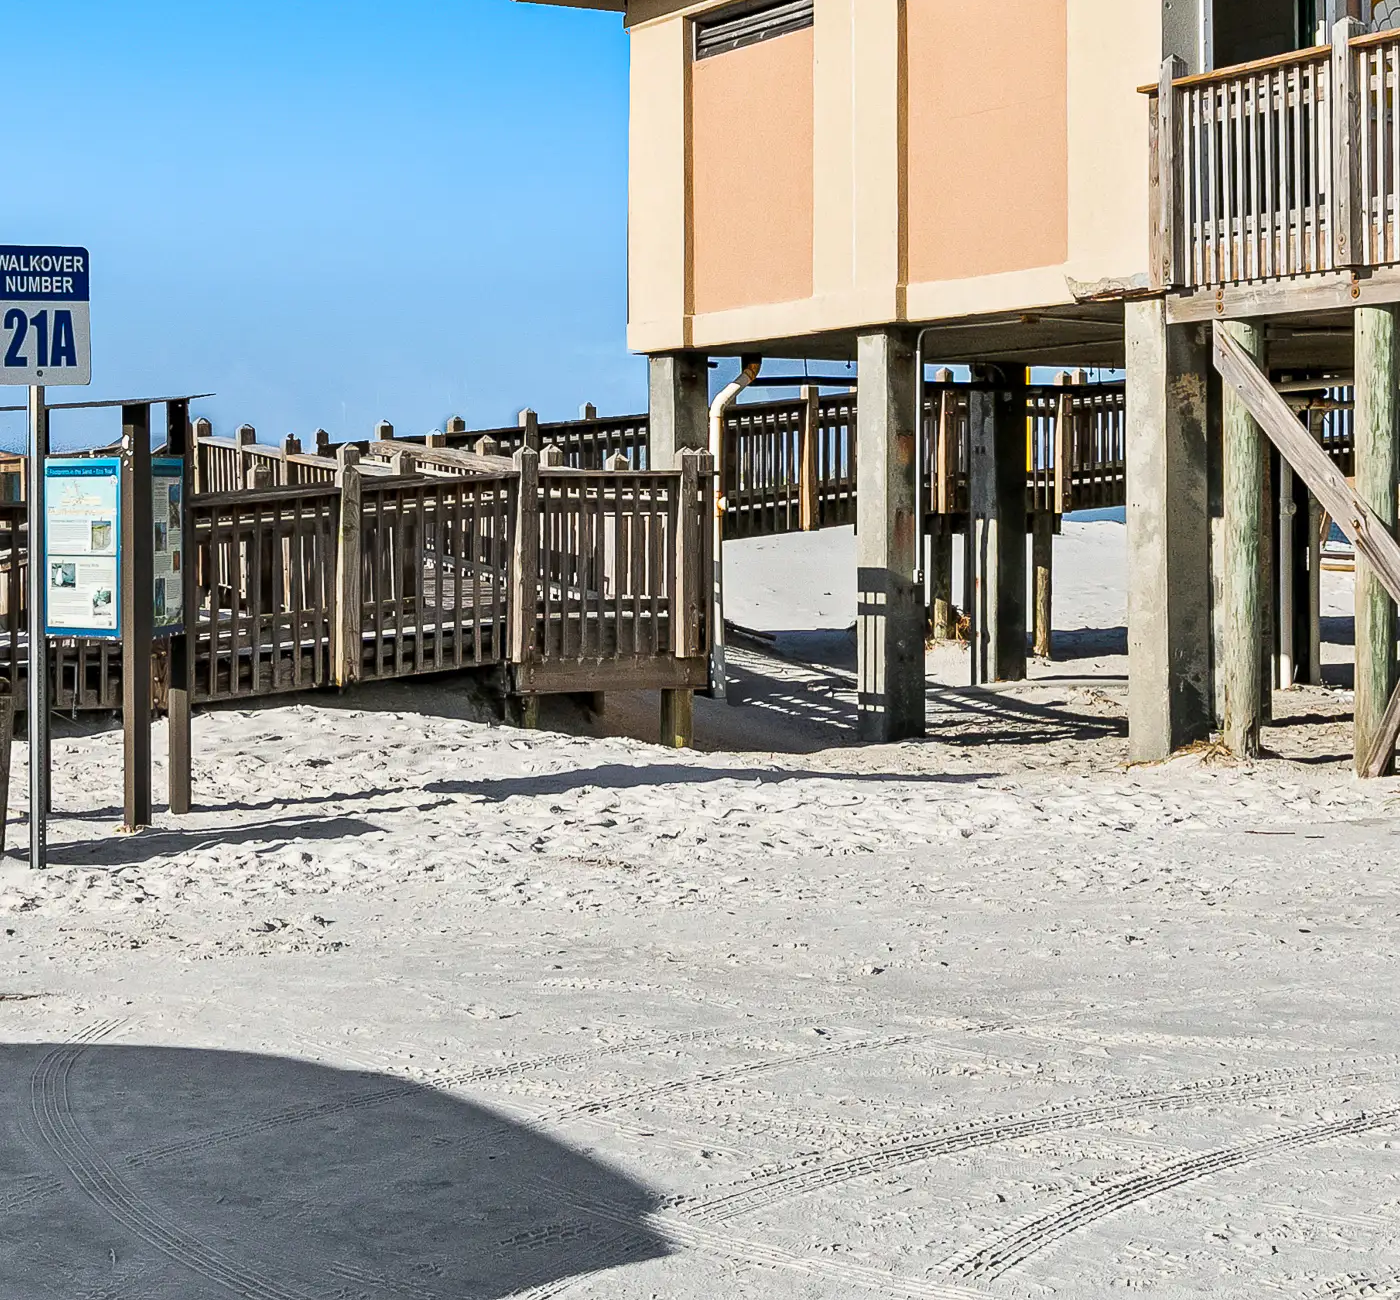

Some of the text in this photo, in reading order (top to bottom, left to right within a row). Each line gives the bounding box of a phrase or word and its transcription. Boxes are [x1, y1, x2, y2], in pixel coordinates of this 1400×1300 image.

[0, 255, 84, 272] WALKOVER
[5, 276, 74, 293] NUMBER
[4, 308, 77, 367] 21A
